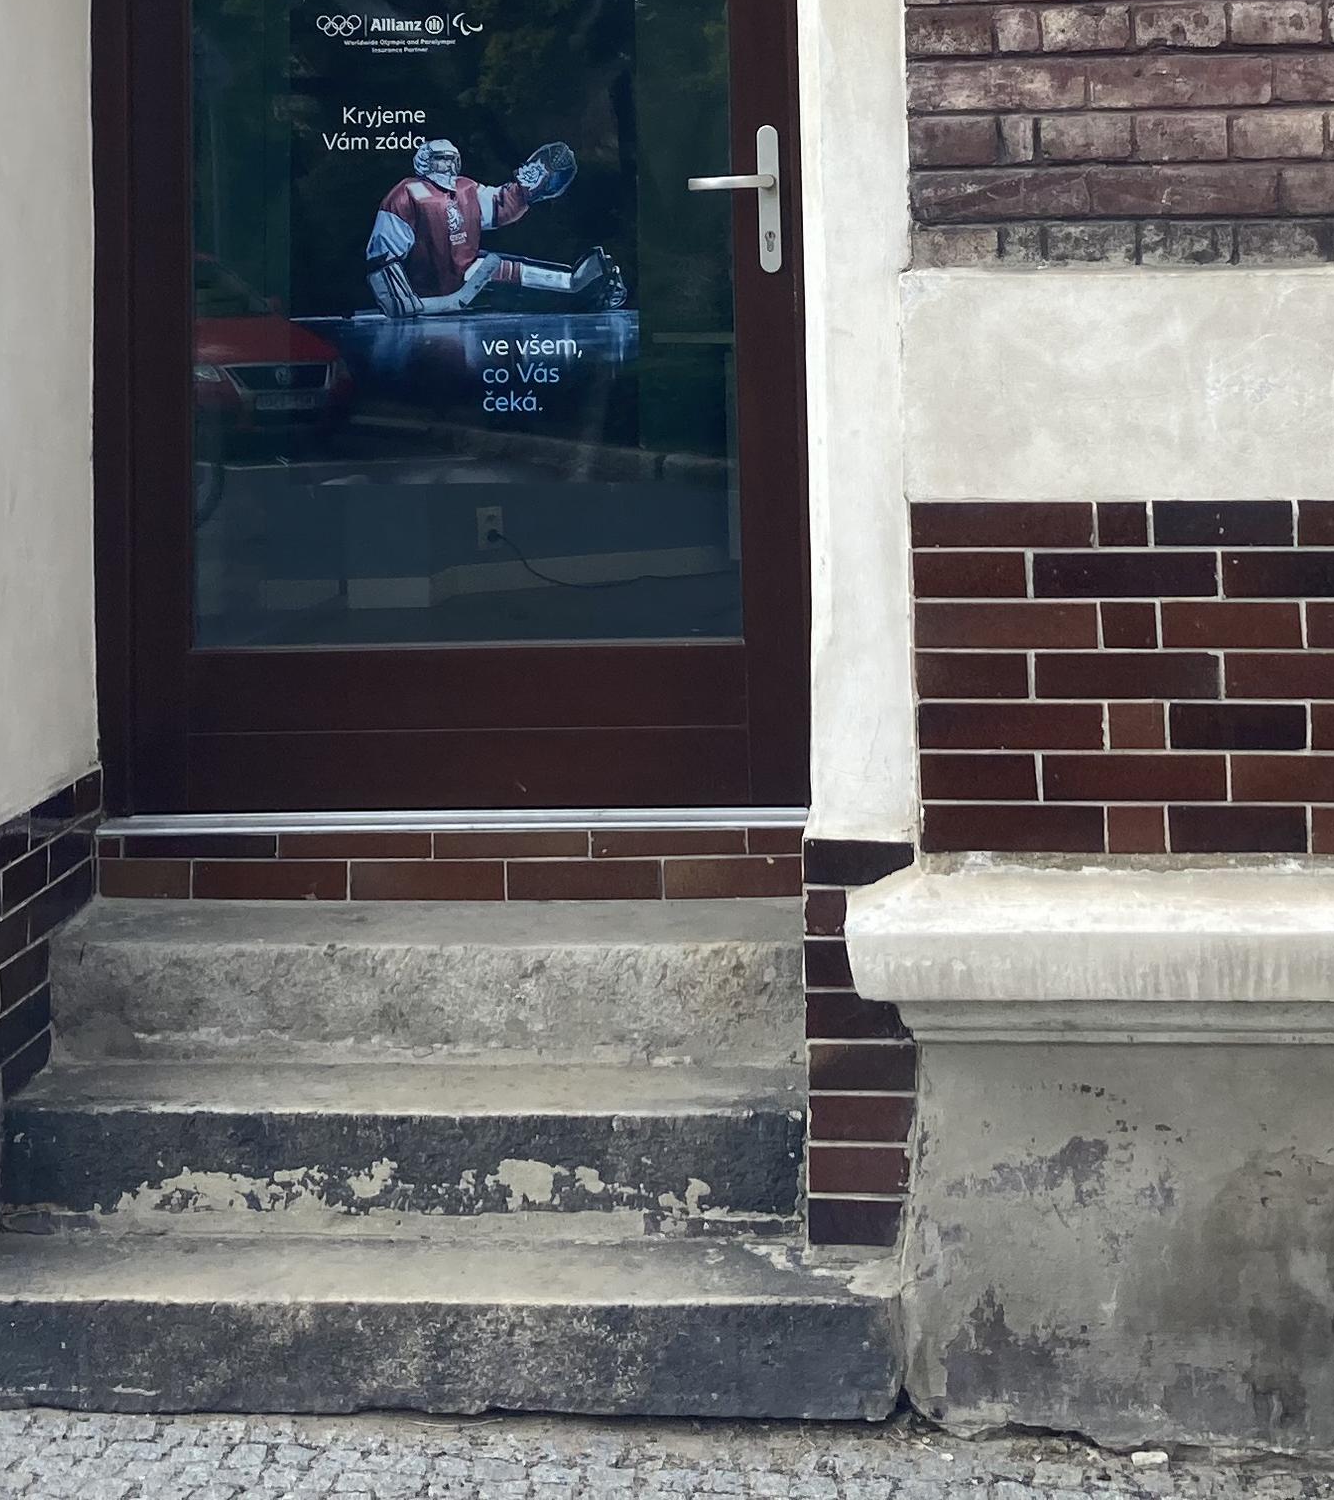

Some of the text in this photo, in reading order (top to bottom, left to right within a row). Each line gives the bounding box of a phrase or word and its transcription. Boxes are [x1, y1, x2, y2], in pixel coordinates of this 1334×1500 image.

[370, 18, 422, 31] Allianz
[343, 105, 426, 128] Kryjeme
[322, 131, 369, 150] Vám
[482, 333, 583, 358] ve všem,
[483, 361, 560, 383] co Vás
[483, 390, 544, 411] čeká.
